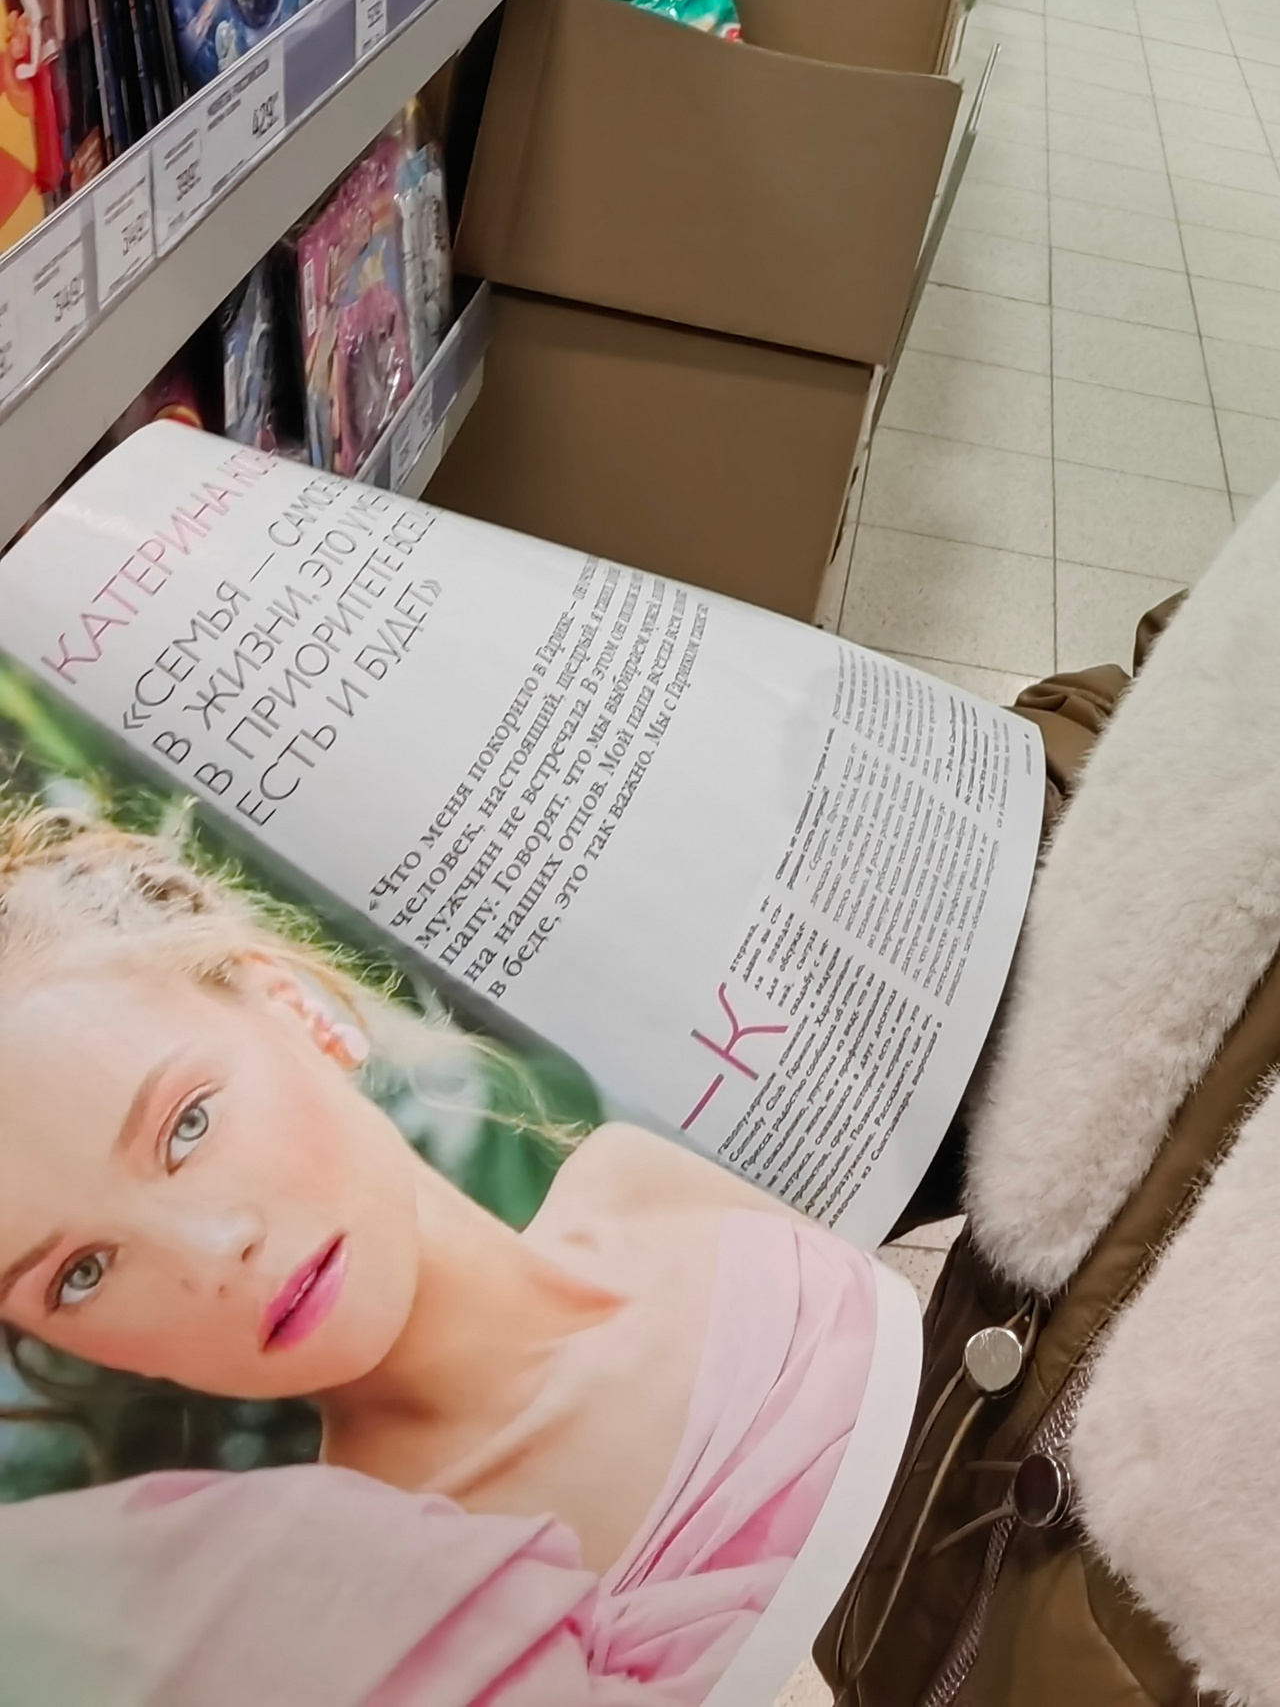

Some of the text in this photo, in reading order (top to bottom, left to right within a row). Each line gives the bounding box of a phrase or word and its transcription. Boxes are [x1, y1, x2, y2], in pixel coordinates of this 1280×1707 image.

[40, 484, 229, 685] КАТЕРИНА
[123, 581, 249, 730] «СЕМЬЯ
[152, 732, 191, 764] В
[299, 530, 356, 587] ЭТО
[194, 763, 233, 795] В
[225, 548, 403, 760] ПРИОРИТЕТЕ
[235, 581, 437, 826] ЕСТЬ И БУДЕТ»
[389, 824, 485, 927] человек,
[478, 694, 563, 818] настоящий,
[556, 624, 598, 690] щедрый,
[415, 841, 503, 949] мужчин
[498, 806, 525, 840] не
[521, 699, 591, 805] встречала.
[580, 678, 598, 695] В
[592, 640, 618, 681] этом
[420, 783, 473, 849] меня
[467, 678, 538, 782] покорило
[533, 664, 546, 677] в
[439, 635, 649, 965] папу. Говорят, что мы выбираем
[464, 948, 498, 982] на
[494, 854, 563, 945] наших
[559, 782, 608, 851] отцов.
[598, 729, 634, 776] Мой
[626, 686, 655, 730] папа
[488, 981, 506, 998] в
[503, 917, 559, 976] беде,
[555, 865, 587, 909] это
[584, 819, 615, 860] так
[608, 751, 654, 819] важно.
[645, 712, 671, 746] Мы
[664, 699, 676, 711] с
